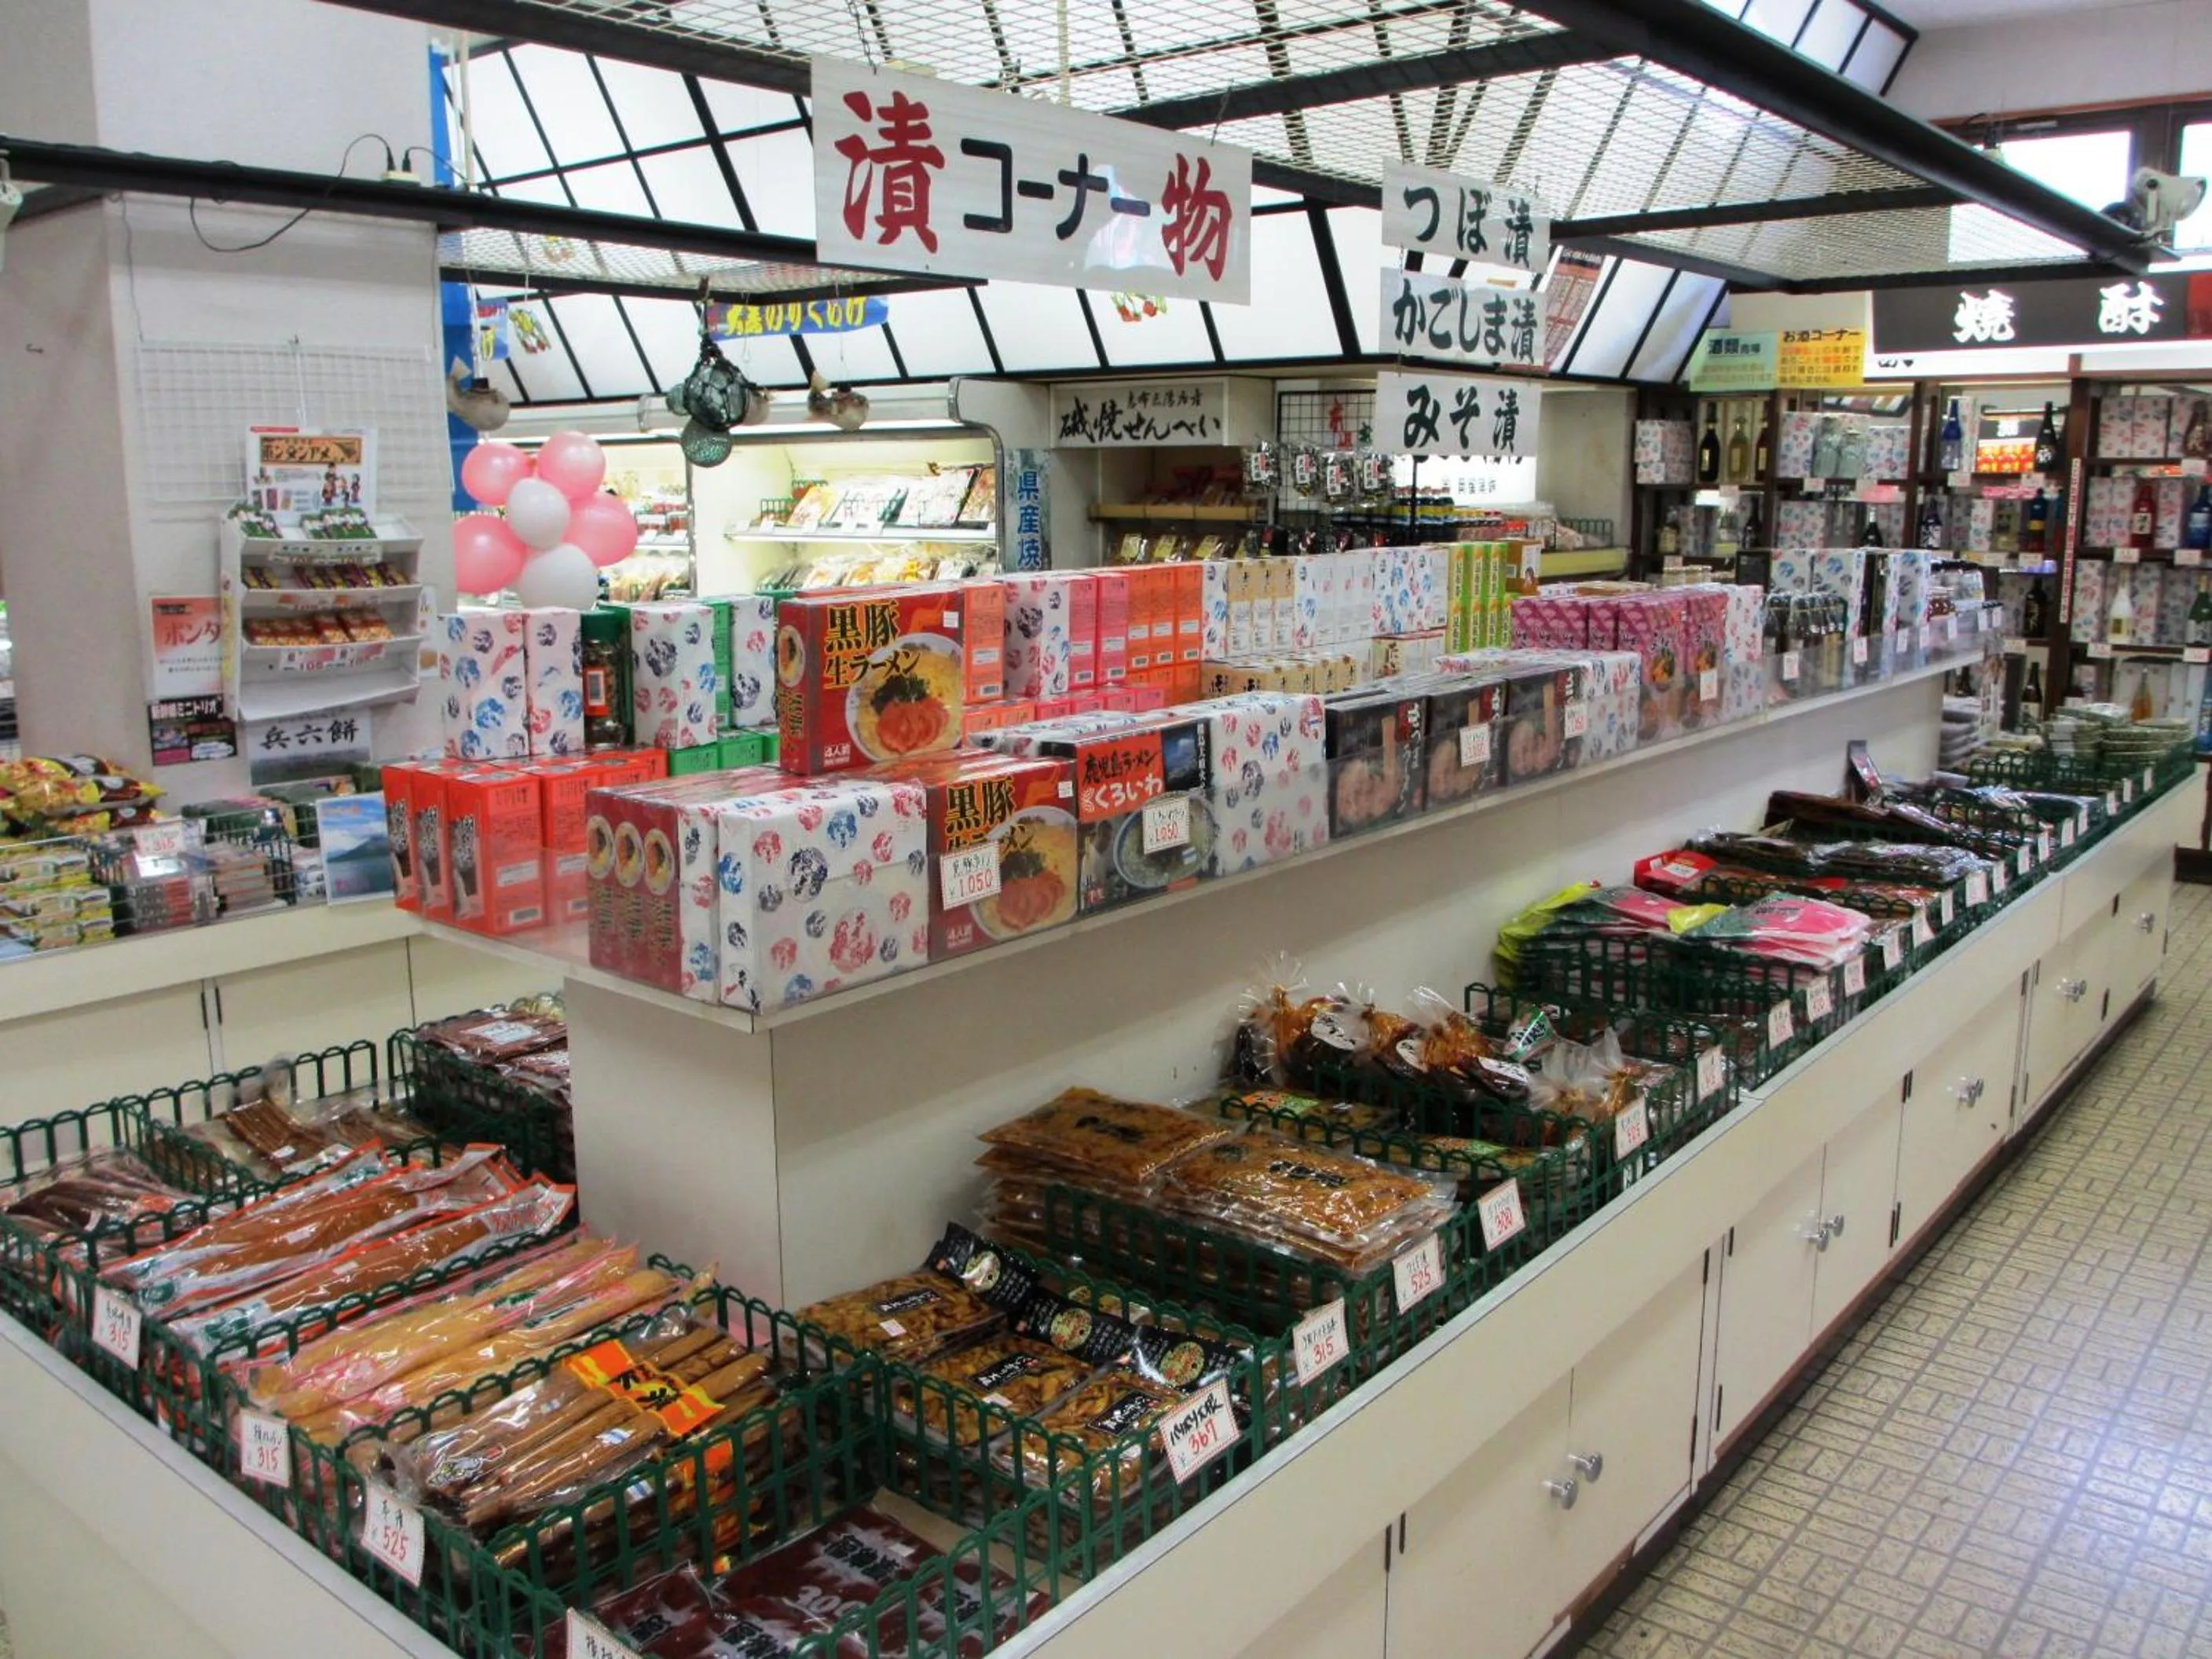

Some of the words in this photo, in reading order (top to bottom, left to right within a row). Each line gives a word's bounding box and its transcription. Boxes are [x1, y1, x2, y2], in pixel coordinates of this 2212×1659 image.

[1404, 186, 1534, 268] つぼ漬
[1393, 278, 1538, 364] かごしま漬
[1403, 384, 1520, 452] みそ漬
[826, 602, 900, 652] 黒豚
[824, 650, 921, 689] 生ラーメン
[261, 720, 360, 749] 兵六餅
[945, 775, 1016, 834] 黒豚
[1095, 772, 1163, 810] くろいわ
[1312, 1335, 1335, 1365] 315
[1187, 1418, 1219, 1455] 367
[257, 1446, 280, 1472] 315
[383, 1525, 411, 1562] 525
